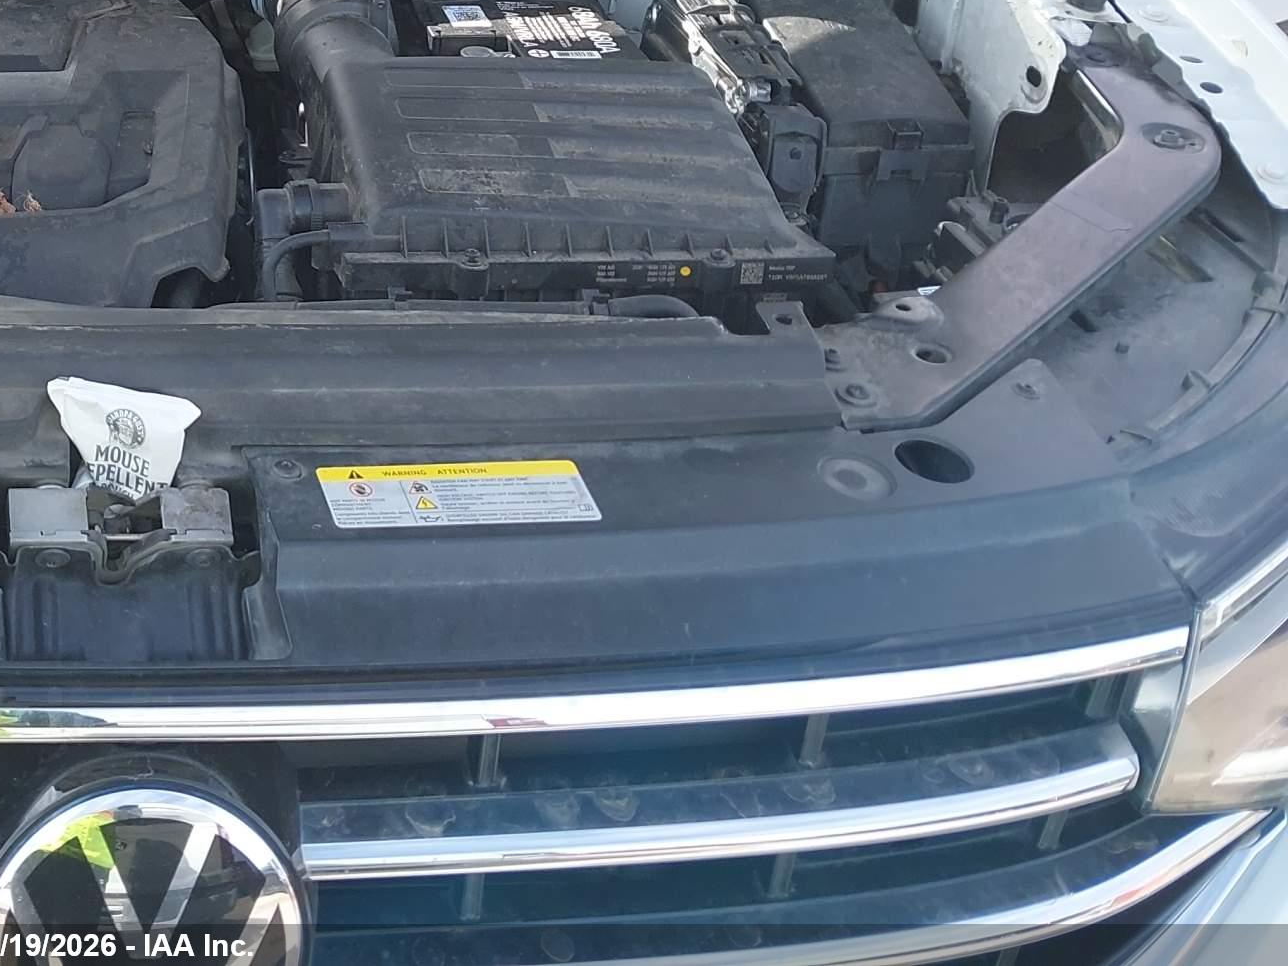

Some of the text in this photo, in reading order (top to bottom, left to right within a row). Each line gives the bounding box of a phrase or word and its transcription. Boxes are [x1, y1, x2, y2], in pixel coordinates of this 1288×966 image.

[585, 30, 621, 54] 680A
[94, 444, 150, 478] MOUSE
[382, 468, 487, 477] WARNING ATTENTION
